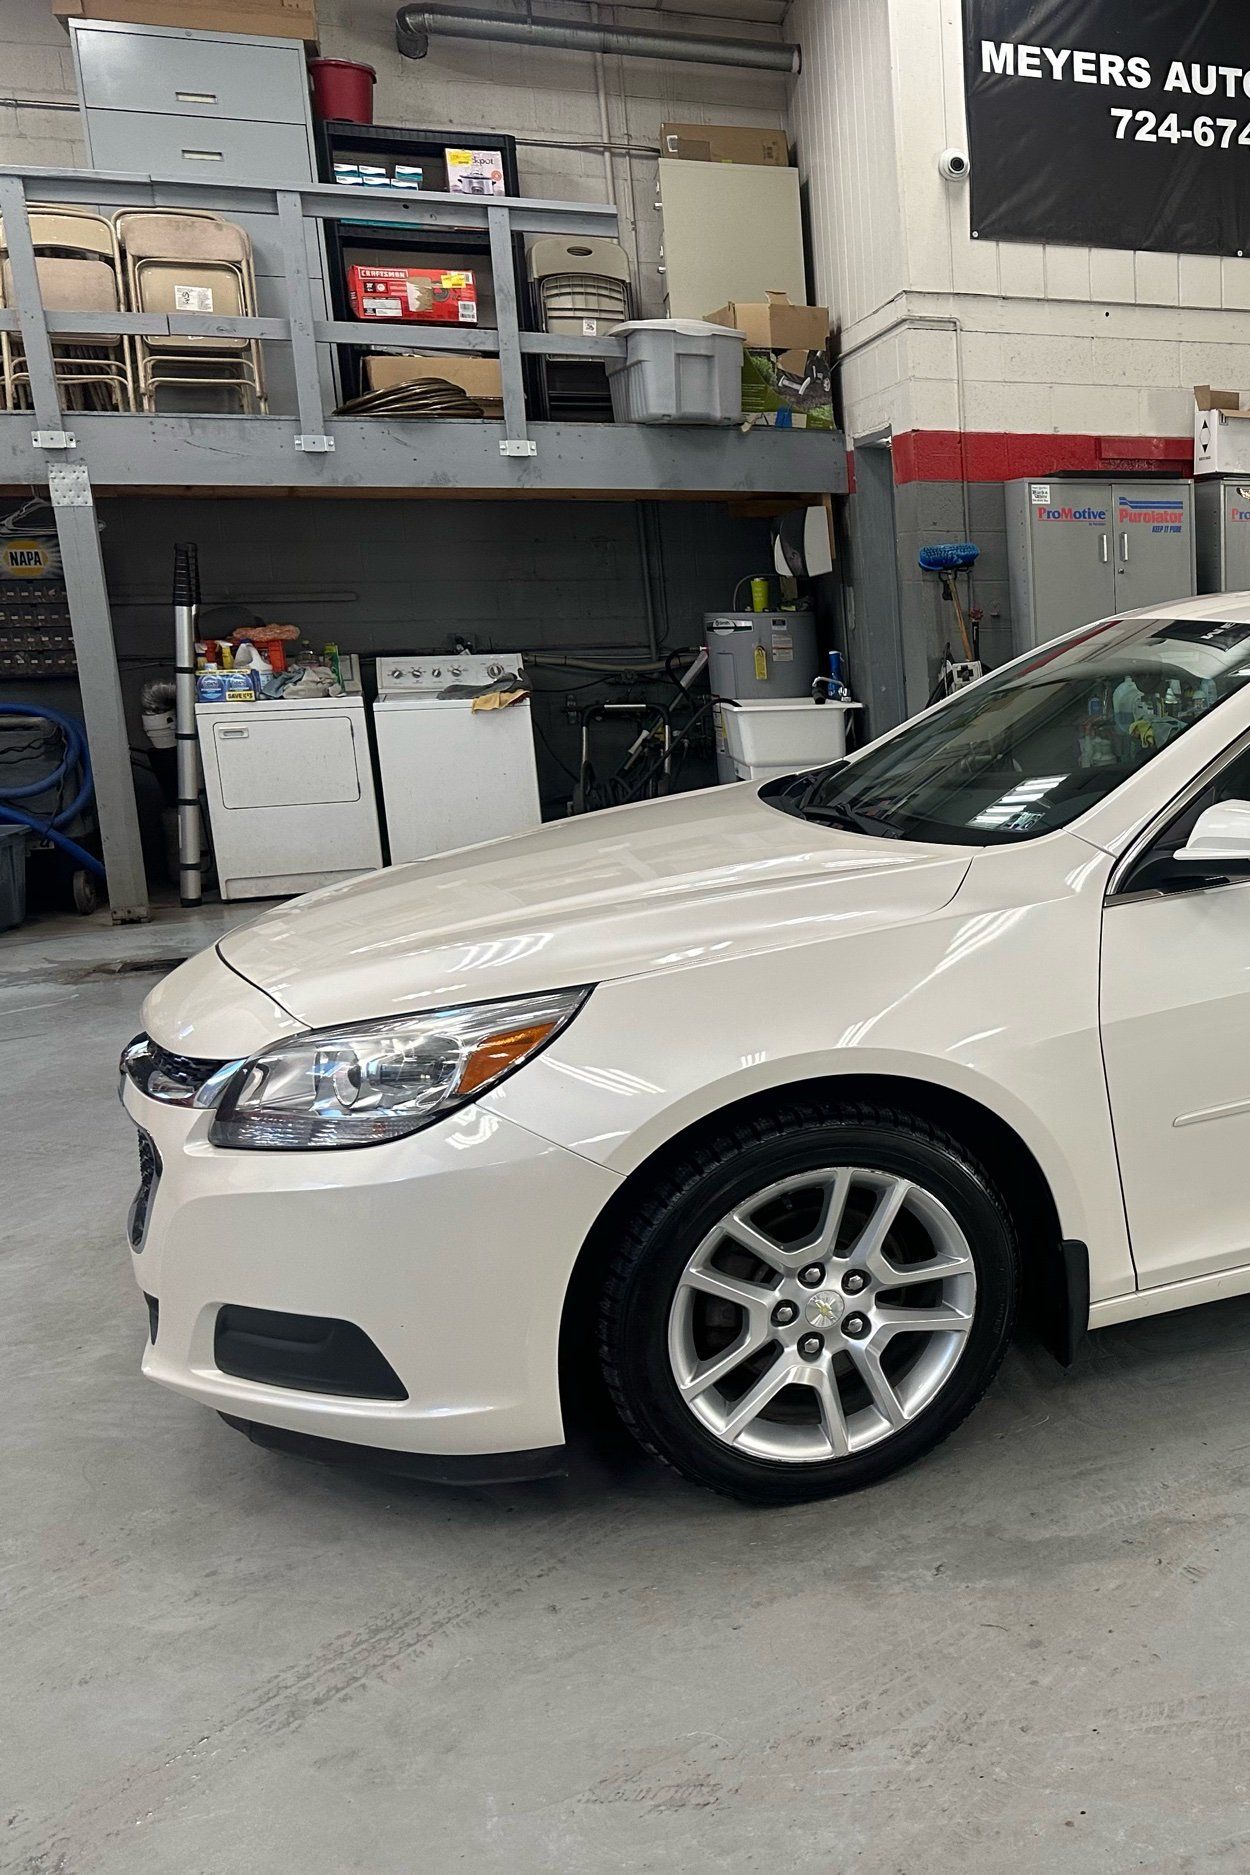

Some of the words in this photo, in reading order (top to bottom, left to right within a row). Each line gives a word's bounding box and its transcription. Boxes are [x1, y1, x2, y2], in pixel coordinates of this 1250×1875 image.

[981, 40, 1151, 89] MEYERS
[361, 270, 405, 278] CRAFTSMAN
[1037, 507, 1106, 520] ProMotive
[1119, 508, 1183, 524] Purolator
[9, 551, 43, 567] NAPA
